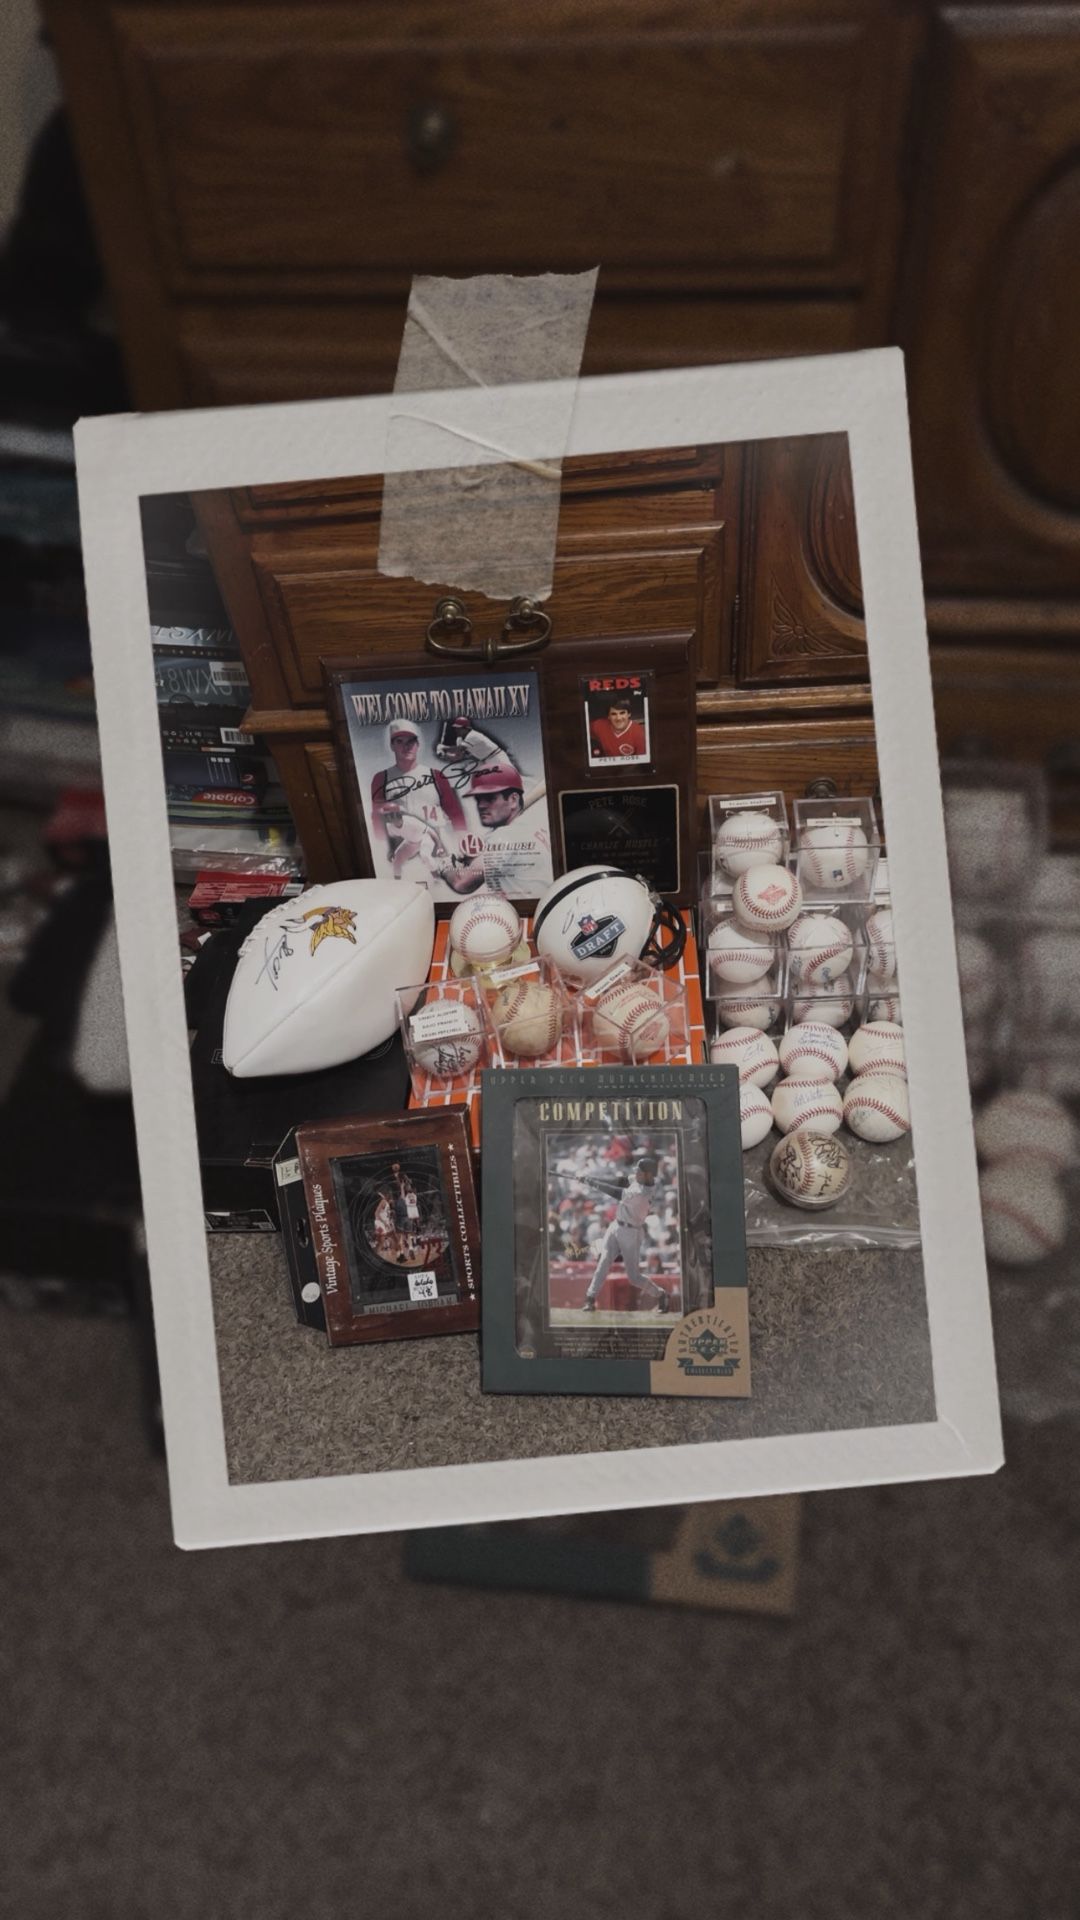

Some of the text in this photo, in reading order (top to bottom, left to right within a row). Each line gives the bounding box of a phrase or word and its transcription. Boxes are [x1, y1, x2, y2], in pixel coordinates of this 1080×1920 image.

[589, 677, 641, 692] REDS
[351, 684, 530, 726] WELCOME TO HAWAII XV
[203, 791, 257, 805] Colgate
[588, 795, 648, 810] PETE ROSE
[422, 806, 439, 822] 14
[460, 834, 484, 857] 14
[580, 841, 619, 851] CHARLIE
[577, 922, 621, 957] DRAFT
[490, 1076, 537, 1086] UPPER
[539, 1100, 682, 1122] COMPETITION
[449, 1155, 474, 1290] SPORTS COLLECTIBLES
[312, 1183, 341, 1295] Vintage Sports Plaques
[678, 1315, 739, 1354] AUTHENTICATED
[689, 1338, 727, 1346] UPPER
